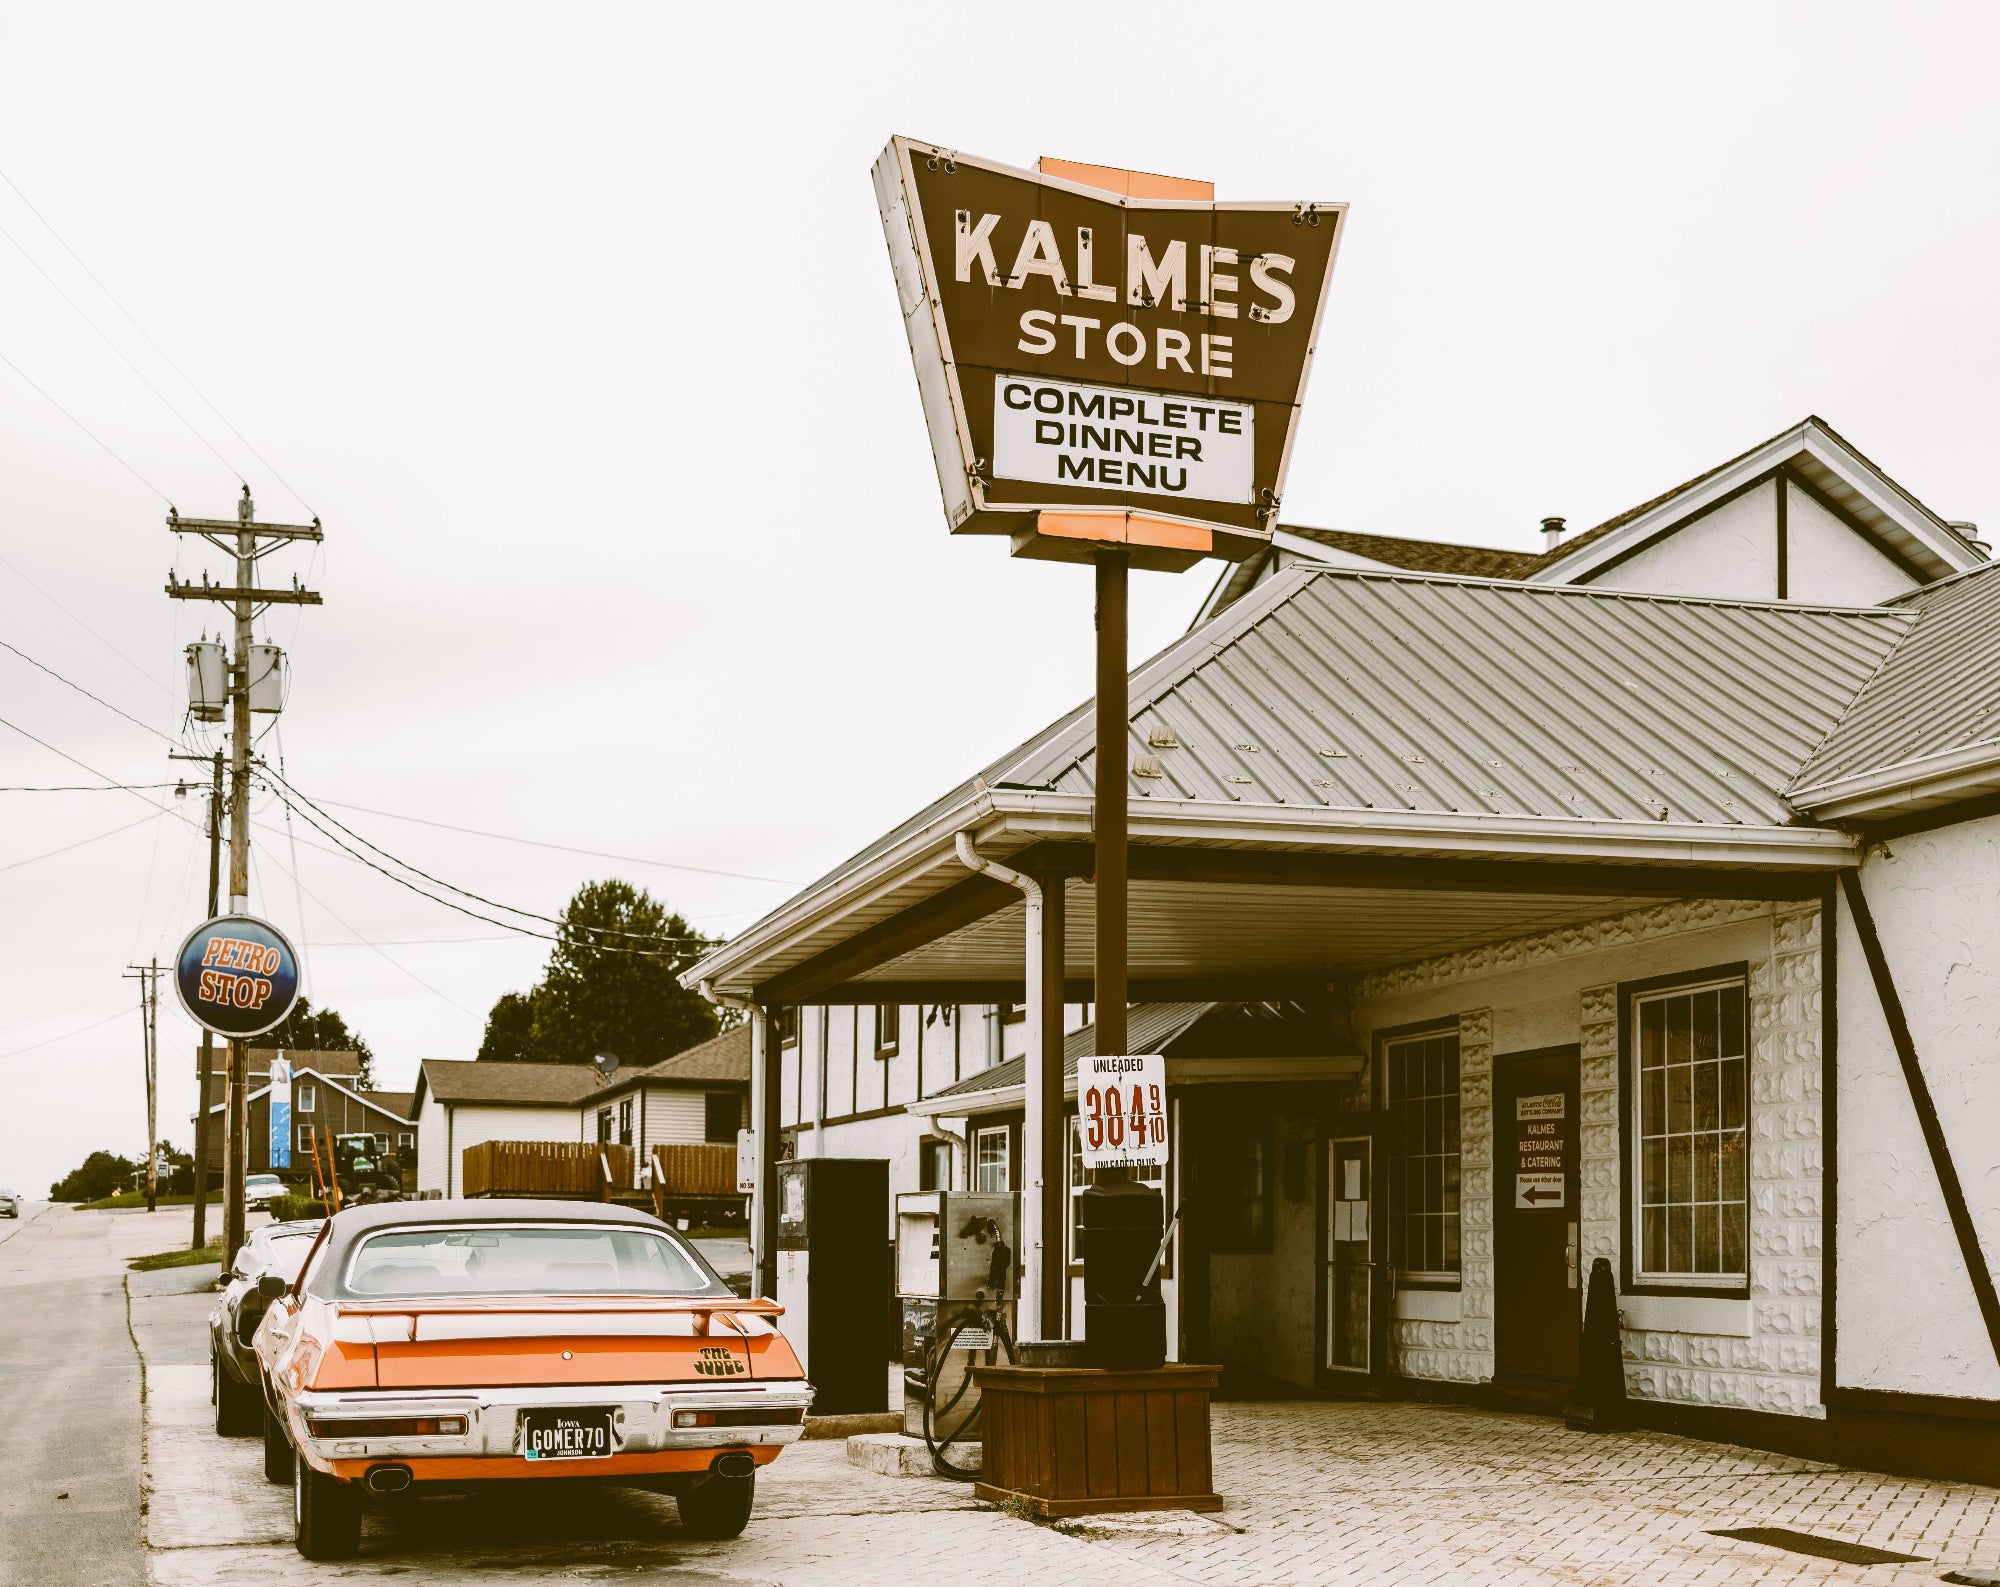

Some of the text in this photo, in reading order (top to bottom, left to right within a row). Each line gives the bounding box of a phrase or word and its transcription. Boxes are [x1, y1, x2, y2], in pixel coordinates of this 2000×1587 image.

[955, 209, 1295, 324] KALMES
[1017, 310, 1233, 378] STORE
[1003, 384, 1242, 435] COMPLETE
[1035, 420, 1203, 462] DINNER
[1057, 455, 1187, 491] MENU
[202, 937, 281, 976] PETRO
[199, 969, 272, 1009] STOP
[1093, 1059, 1143, 1073] UNLEADED
[1519, 1140, 1564, 1151] RESTAURANT
[1527, 1123, 1555, 1135] KALMES
[1521, 1156, 1561, 1168] & CATERING
[699, 1347, 731, 1360] THE
[532, 1427, 604, 1450] GOMER70
